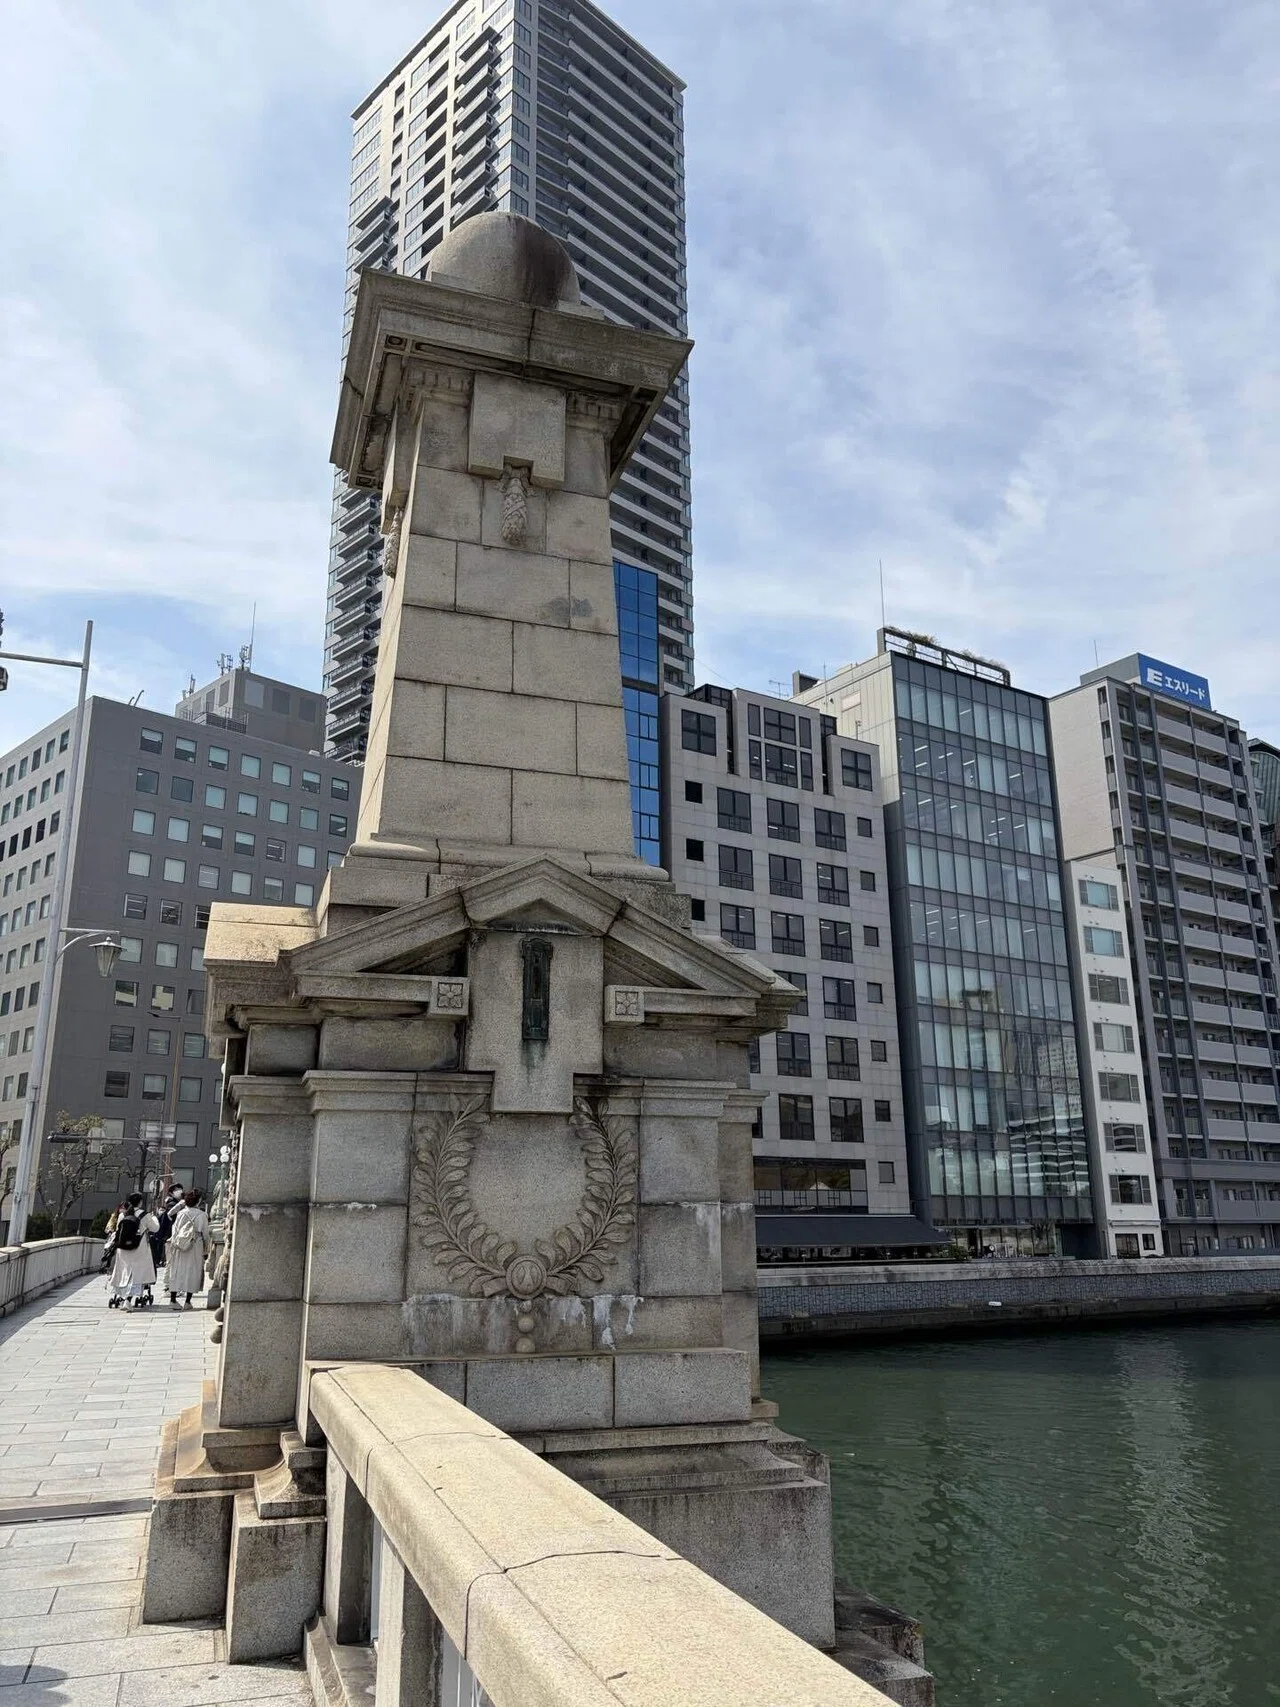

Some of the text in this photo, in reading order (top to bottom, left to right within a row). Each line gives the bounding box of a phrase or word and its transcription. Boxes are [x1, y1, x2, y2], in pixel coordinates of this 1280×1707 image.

[1165, 676, 1205, 700] エスリード
